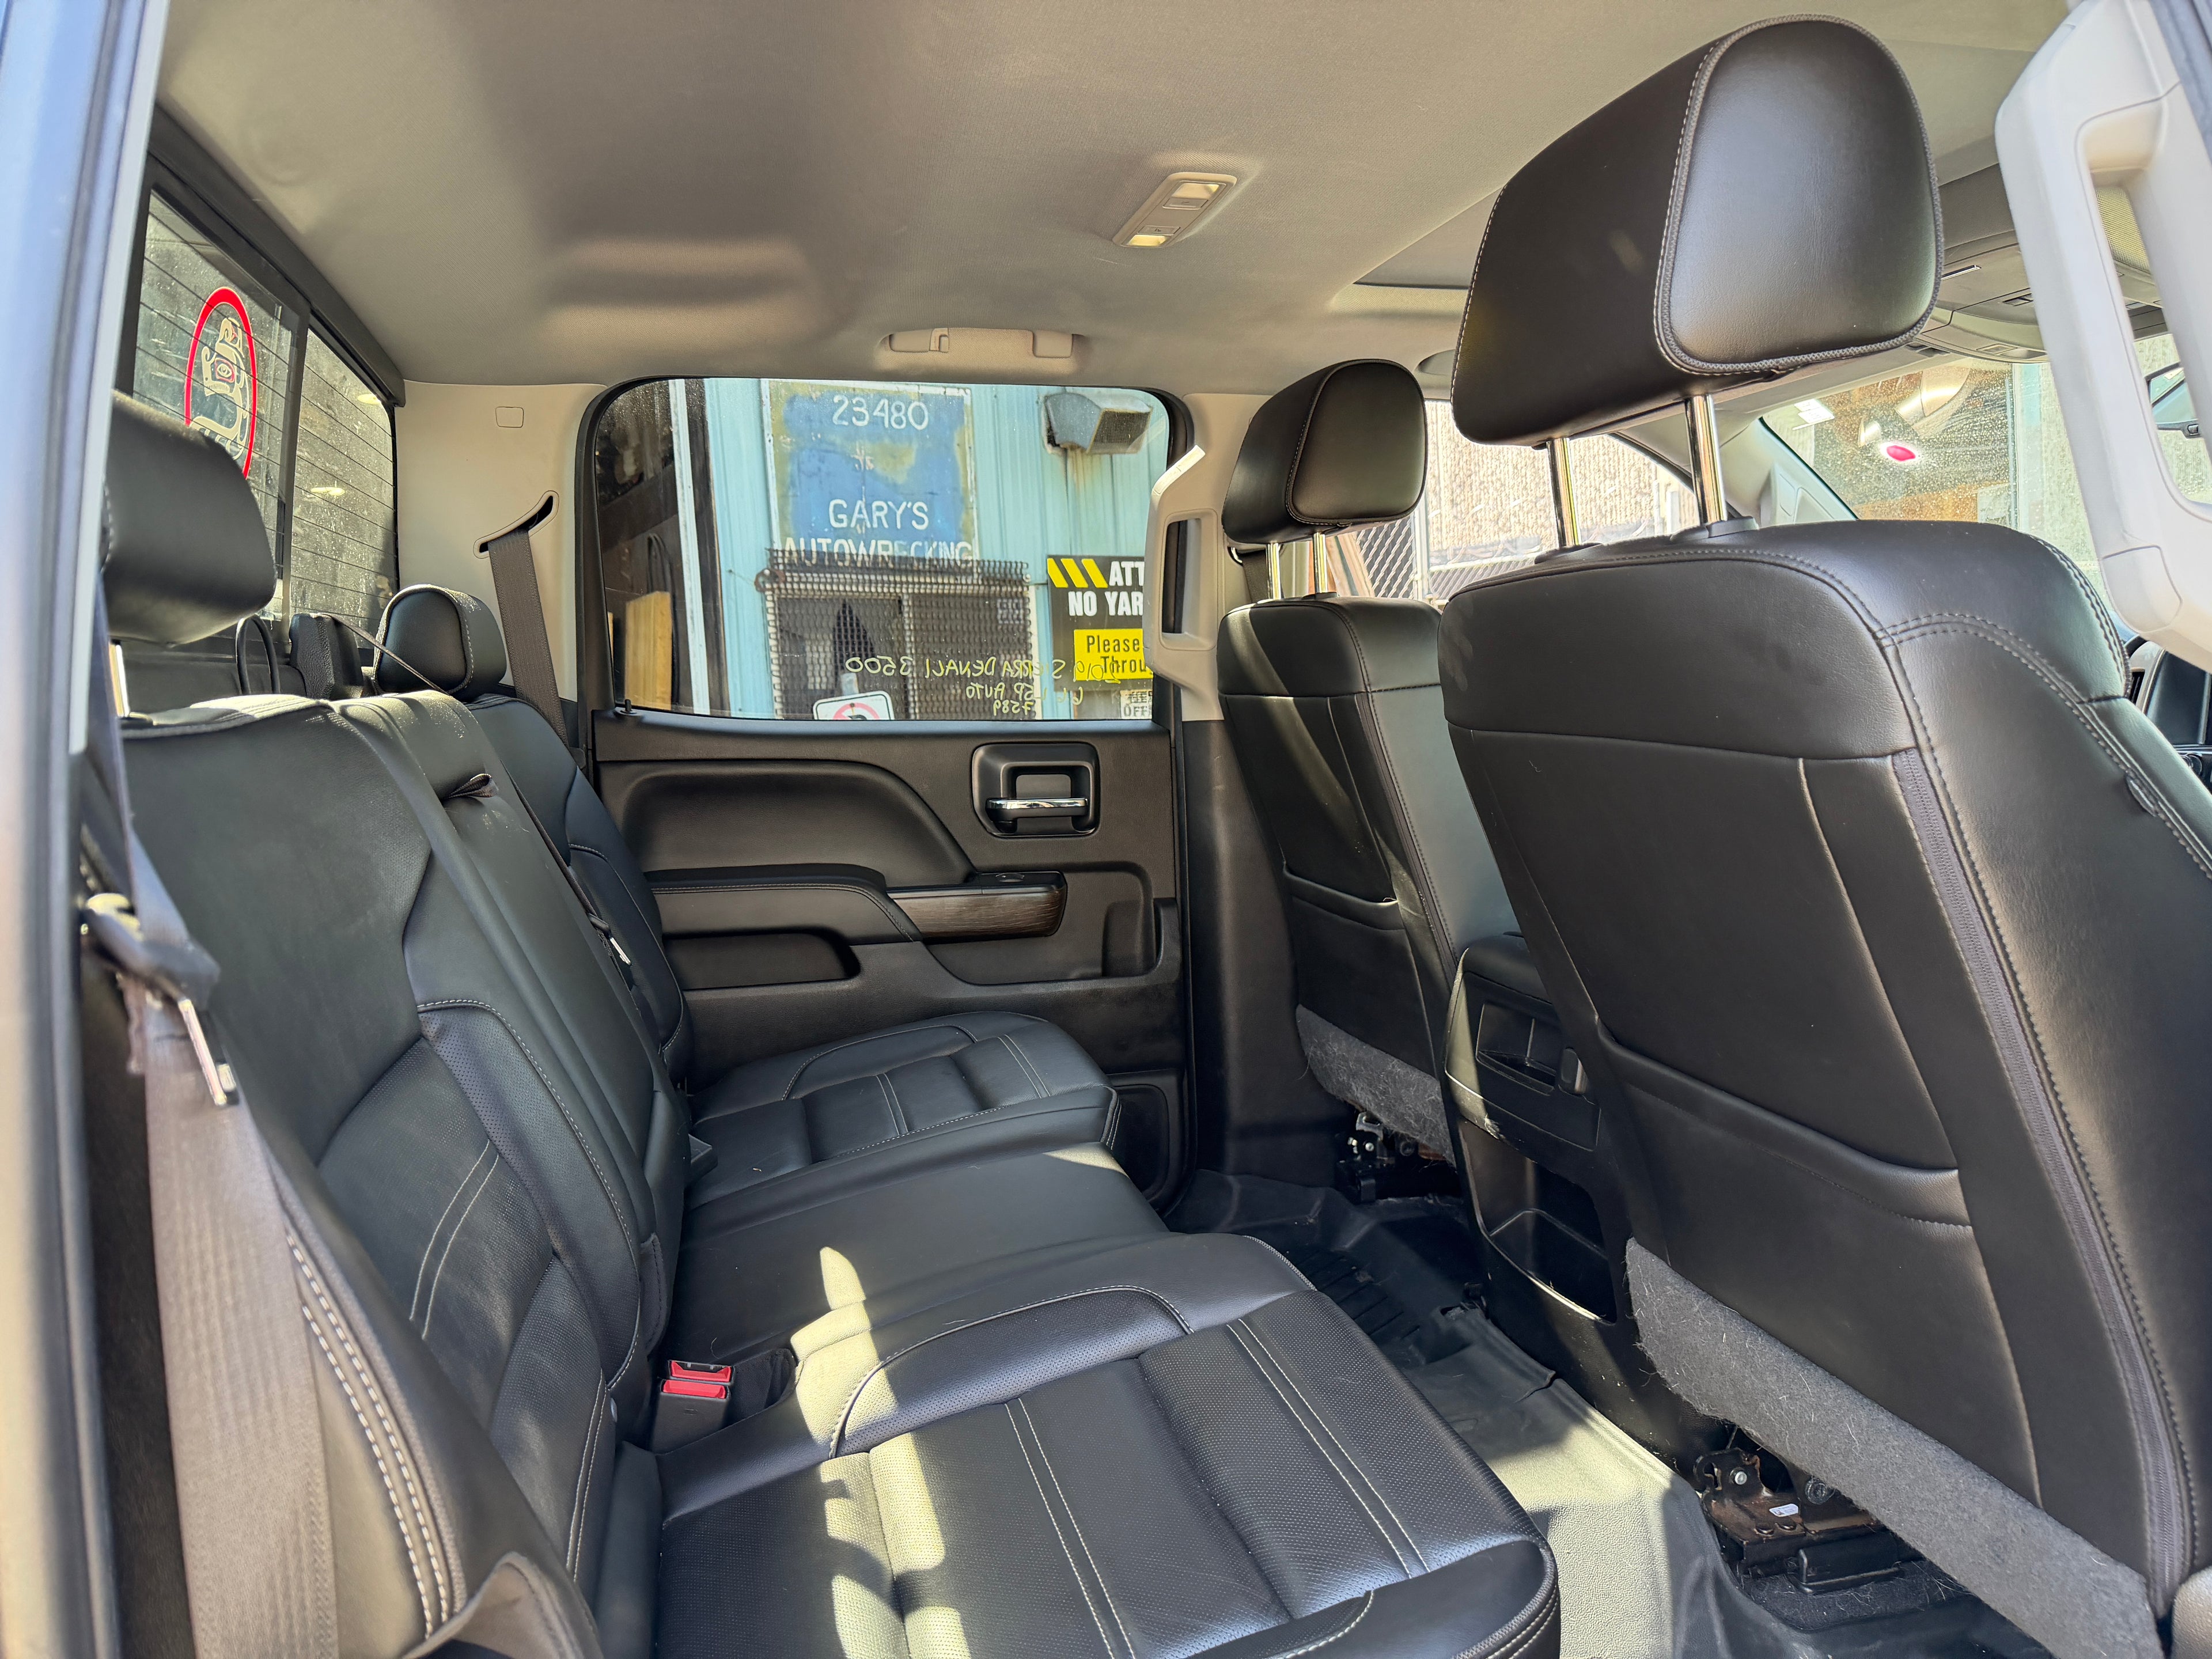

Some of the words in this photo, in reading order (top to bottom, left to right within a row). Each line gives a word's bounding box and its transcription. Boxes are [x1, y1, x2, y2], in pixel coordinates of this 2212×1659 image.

[832, 395, 929, 430] 23480
[828, 499, 929, 530] GARY'S
[783, 537, 973, 569] AUTOWRECKING
[1068, 591, 1097, 616] NO
[1086, 635, 1140, 654] Please
